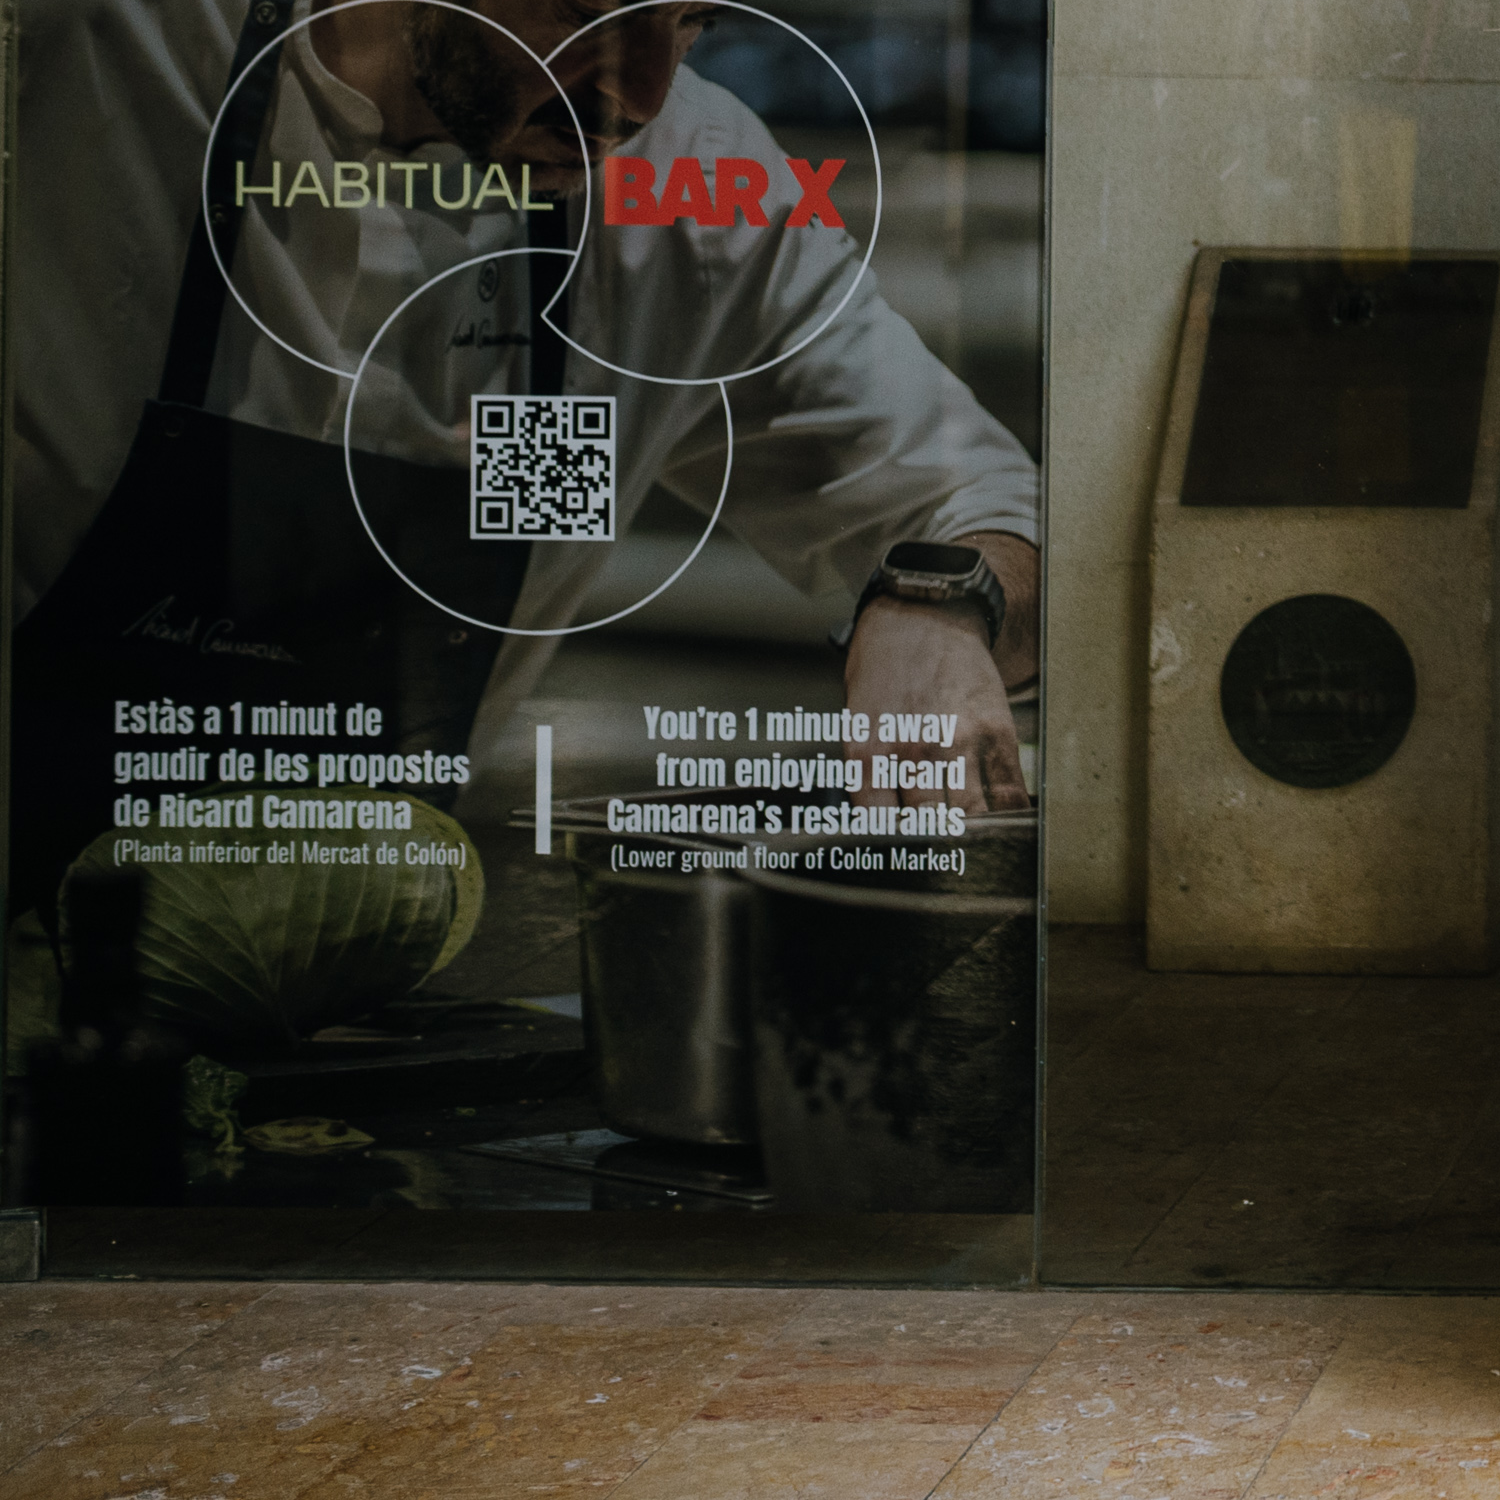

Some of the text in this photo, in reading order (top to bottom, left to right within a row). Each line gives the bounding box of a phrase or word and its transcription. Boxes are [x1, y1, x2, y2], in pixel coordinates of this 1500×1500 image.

[235, 161, 554, 212] HABITUAL
[604, 157, 846, 228] BAR X
[115, 698, 382, 736] Estàs a 1 minut de
[644, 706, 958, 747] You’re 1 minute away
[115, 747, 470, 788] gaudir de les propostes
[657, 753, 966, 792] from enjoying Ricard
[114, 793, 412, 829] de Ricard Camarena
[607, 798, 966, 836] Camarena’s restaurants
[114, 839, 467, 870] (Planta inferior del Mercat de Colón)
[611, 843, 966, 876] (Lower ground floor of Colón Market)
